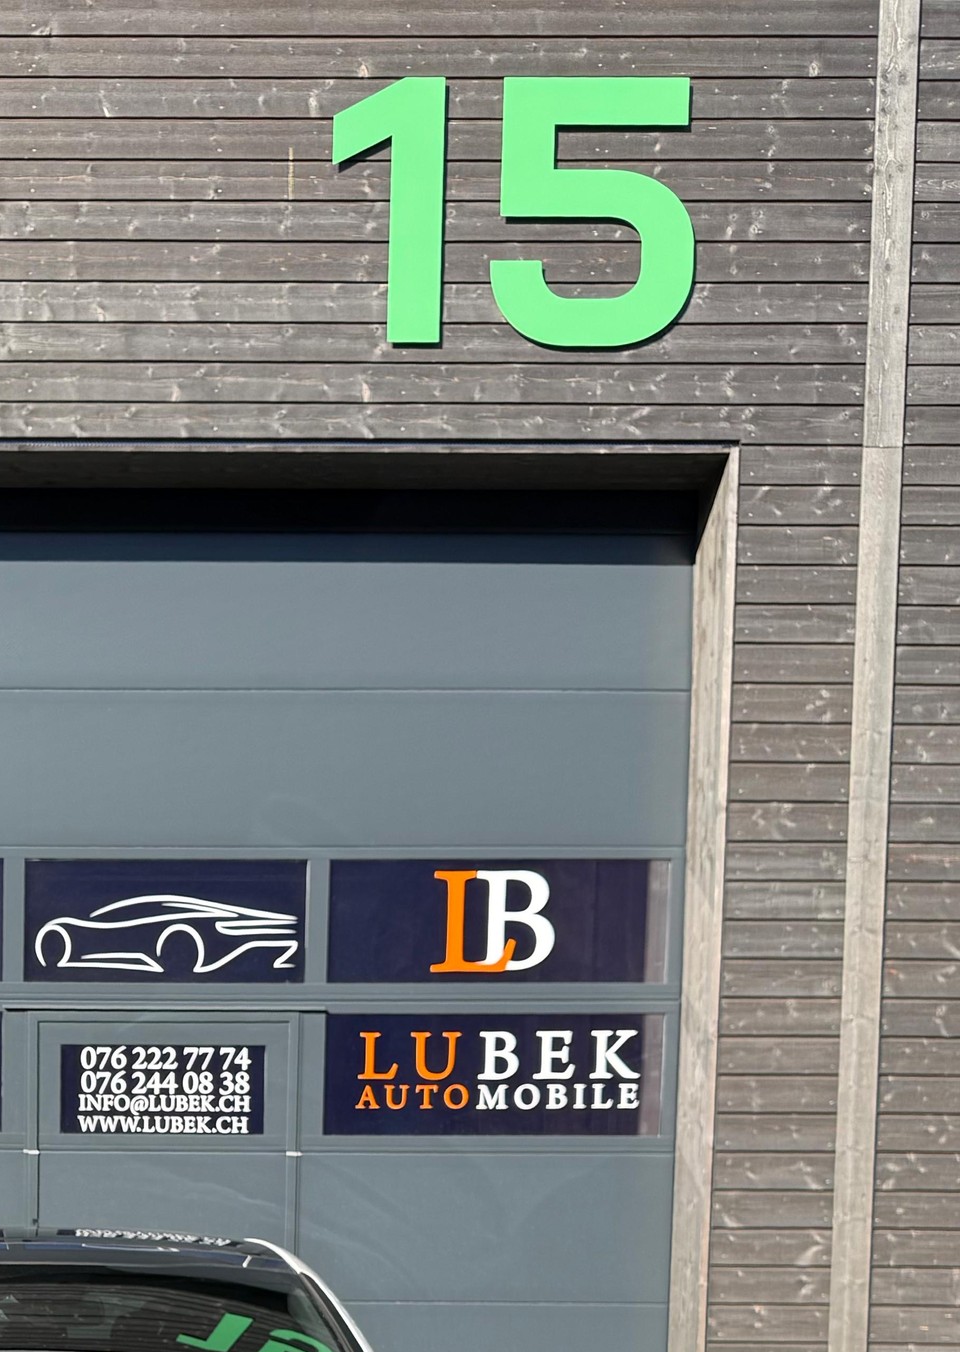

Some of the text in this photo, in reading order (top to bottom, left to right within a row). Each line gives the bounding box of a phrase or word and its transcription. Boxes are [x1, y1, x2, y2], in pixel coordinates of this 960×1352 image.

[331, 76, 696, 348] 15
[80, 1046, 252, 1071] 076 222 77 74
[357, 1030, 641, 1080] LUBEK
[80, 1070, 250, 1095] 076 244 08 38
[78, 1094, 251, 1115] INFO@LUBEK.CH
[354, 1083, 641, 1110] AUTOMOBILE
[77, 1115, 249, 1134] WWW.LUBEK.CH
